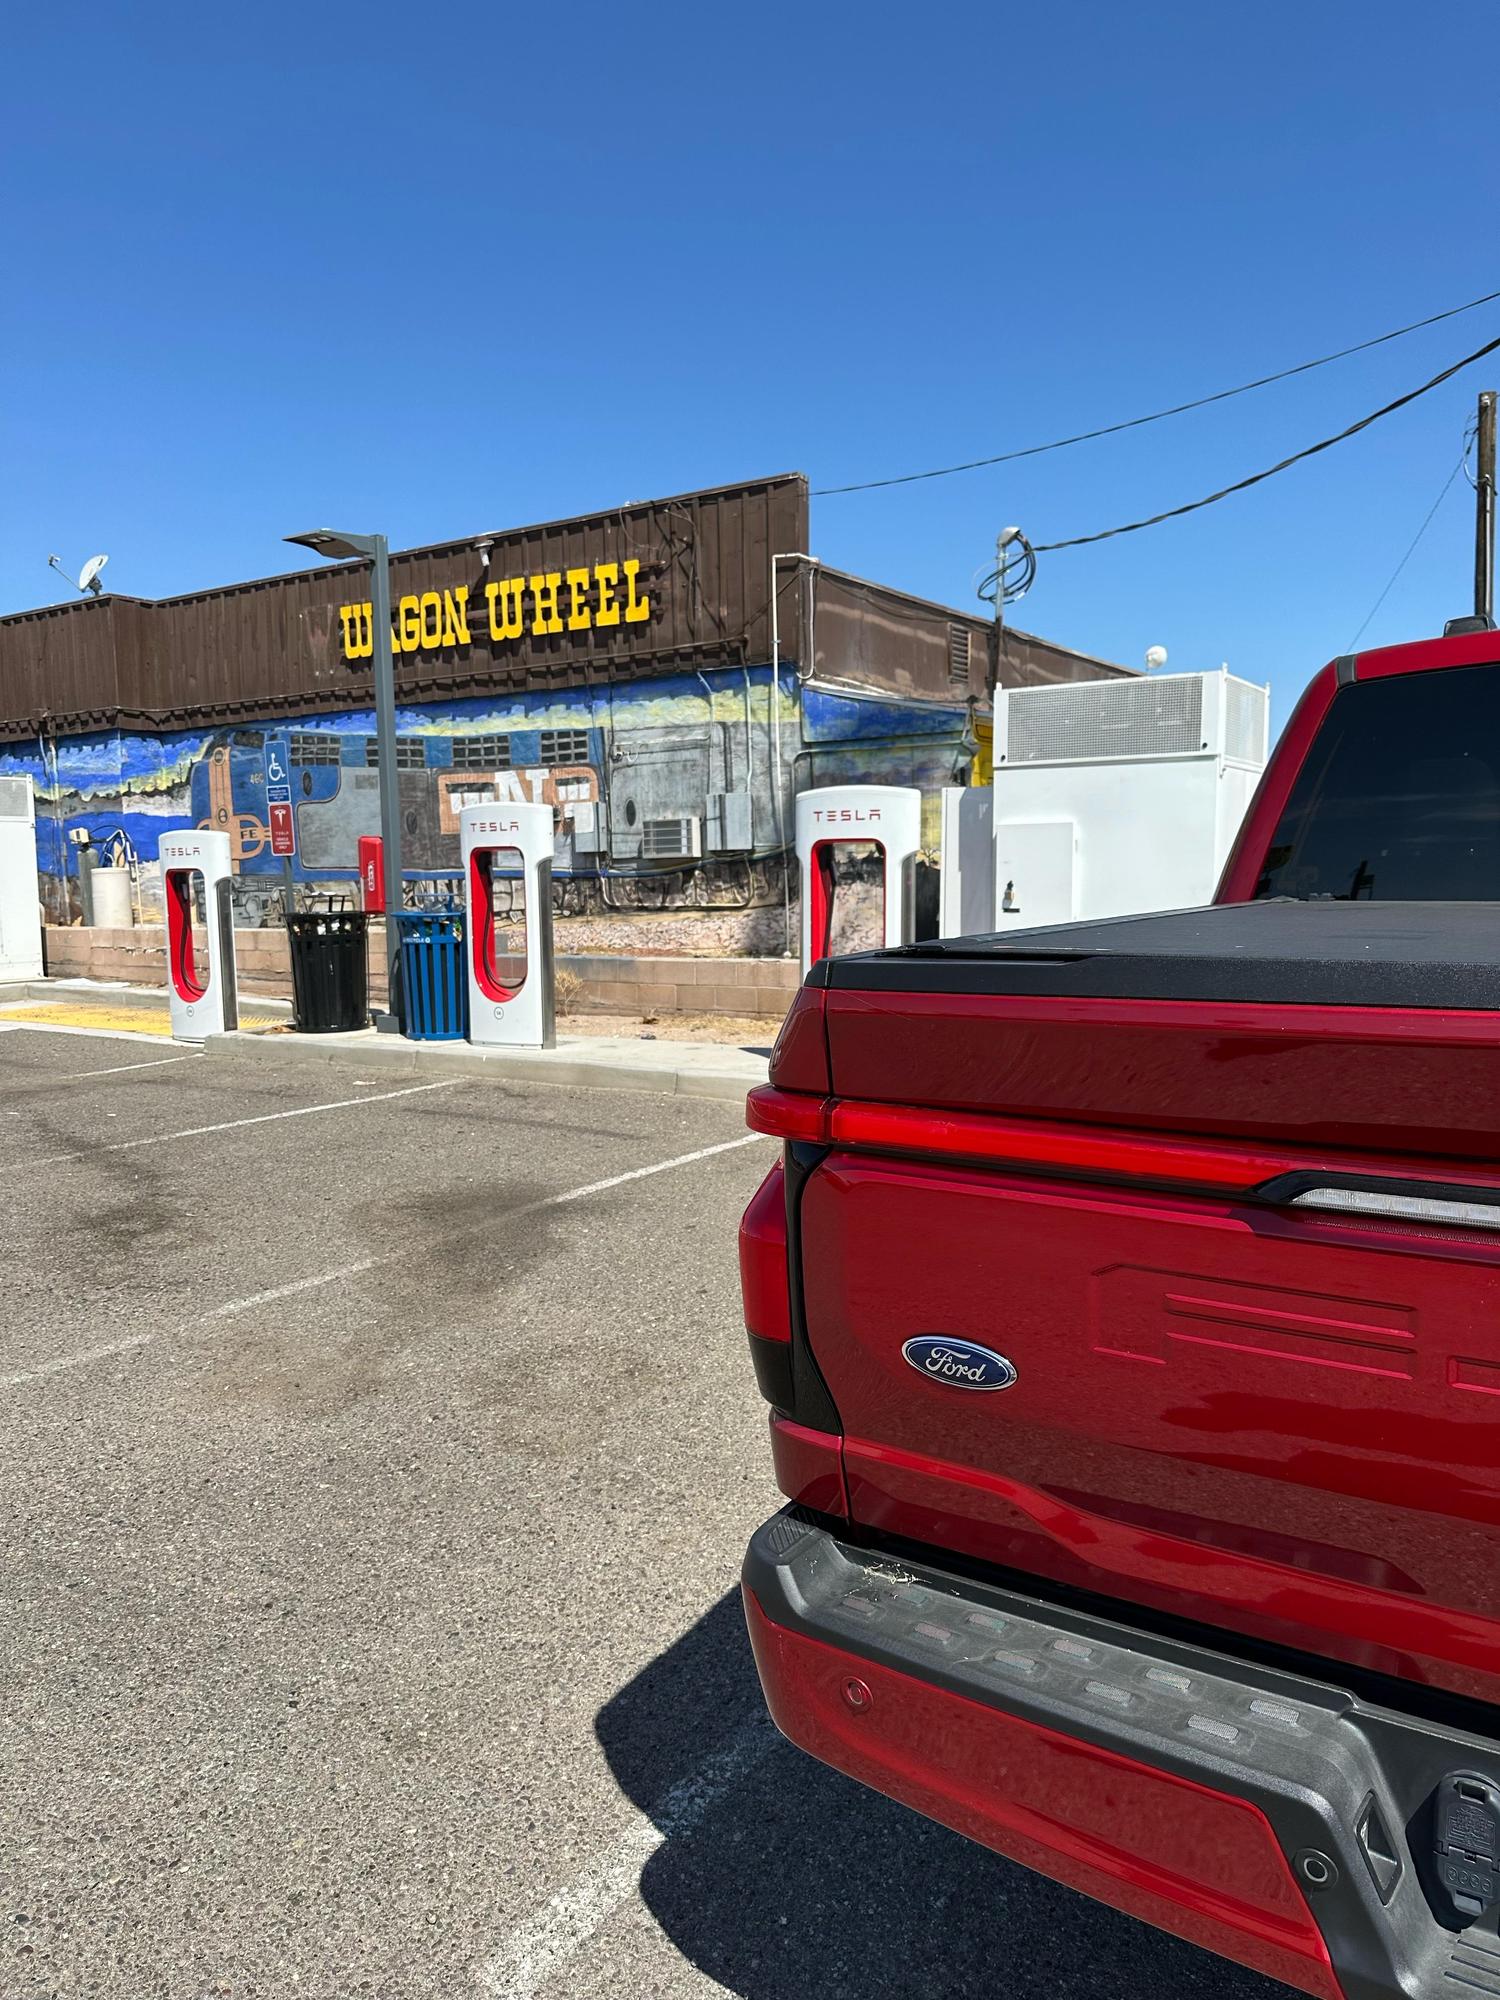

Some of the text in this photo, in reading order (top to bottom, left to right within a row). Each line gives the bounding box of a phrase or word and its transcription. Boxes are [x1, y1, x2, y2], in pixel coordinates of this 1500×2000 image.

[340, 559, 650, 660] WGON WHEEL
[813, 809, 881, 822] TESLA
[470, 821, 519, 832] TESLA
[165, 847, 200, 856] TESLA
[925, 1346, 987, 1382] Ford
